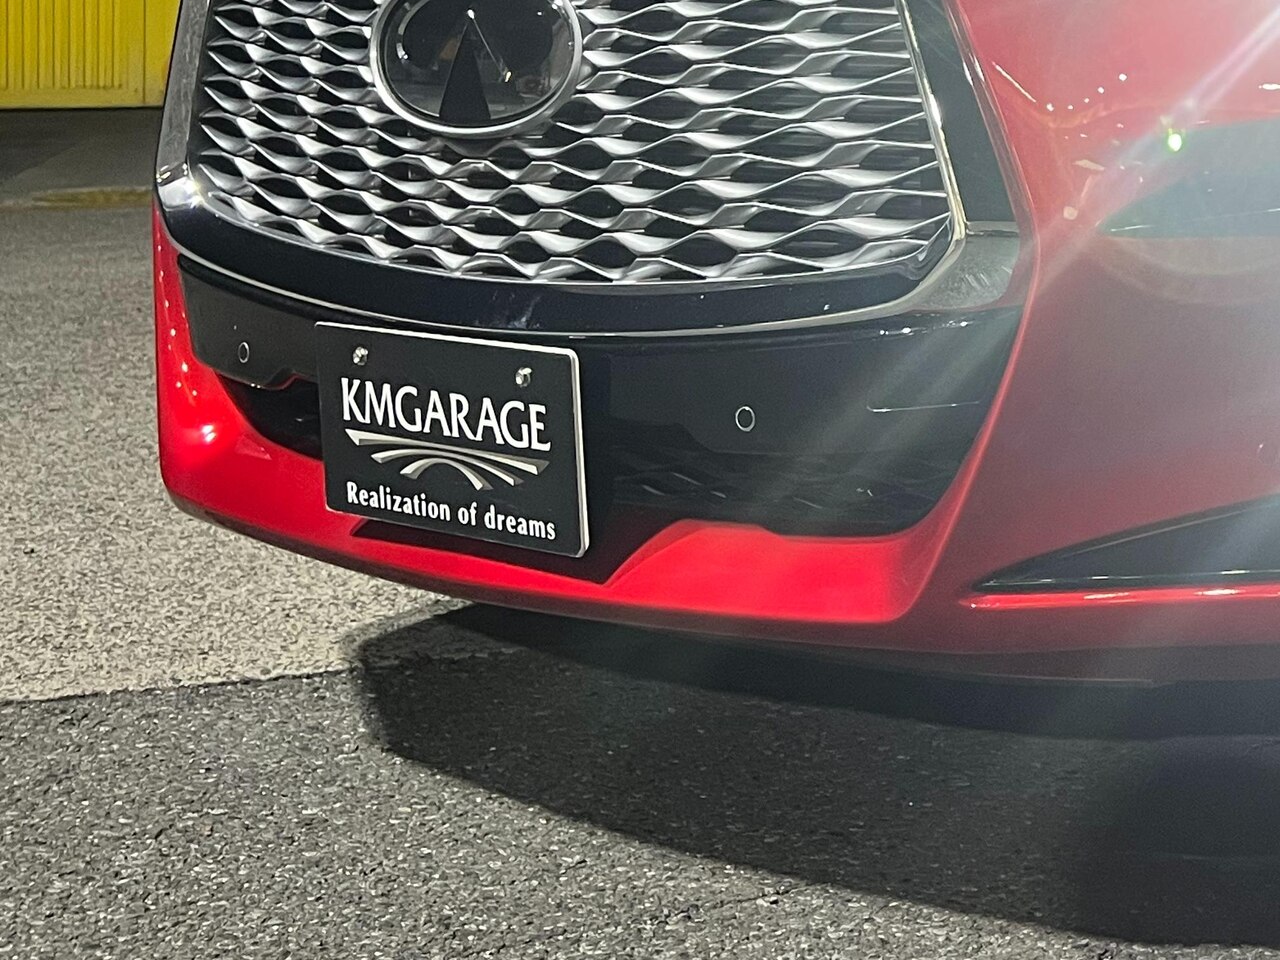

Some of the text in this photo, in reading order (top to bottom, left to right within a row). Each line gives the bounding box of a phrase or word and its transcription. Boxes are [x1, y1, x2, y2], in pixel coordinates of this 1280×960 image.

[340, 377, 551, 451] KMGARAGE
[346, 481, 556, 540] Realization of dreams
